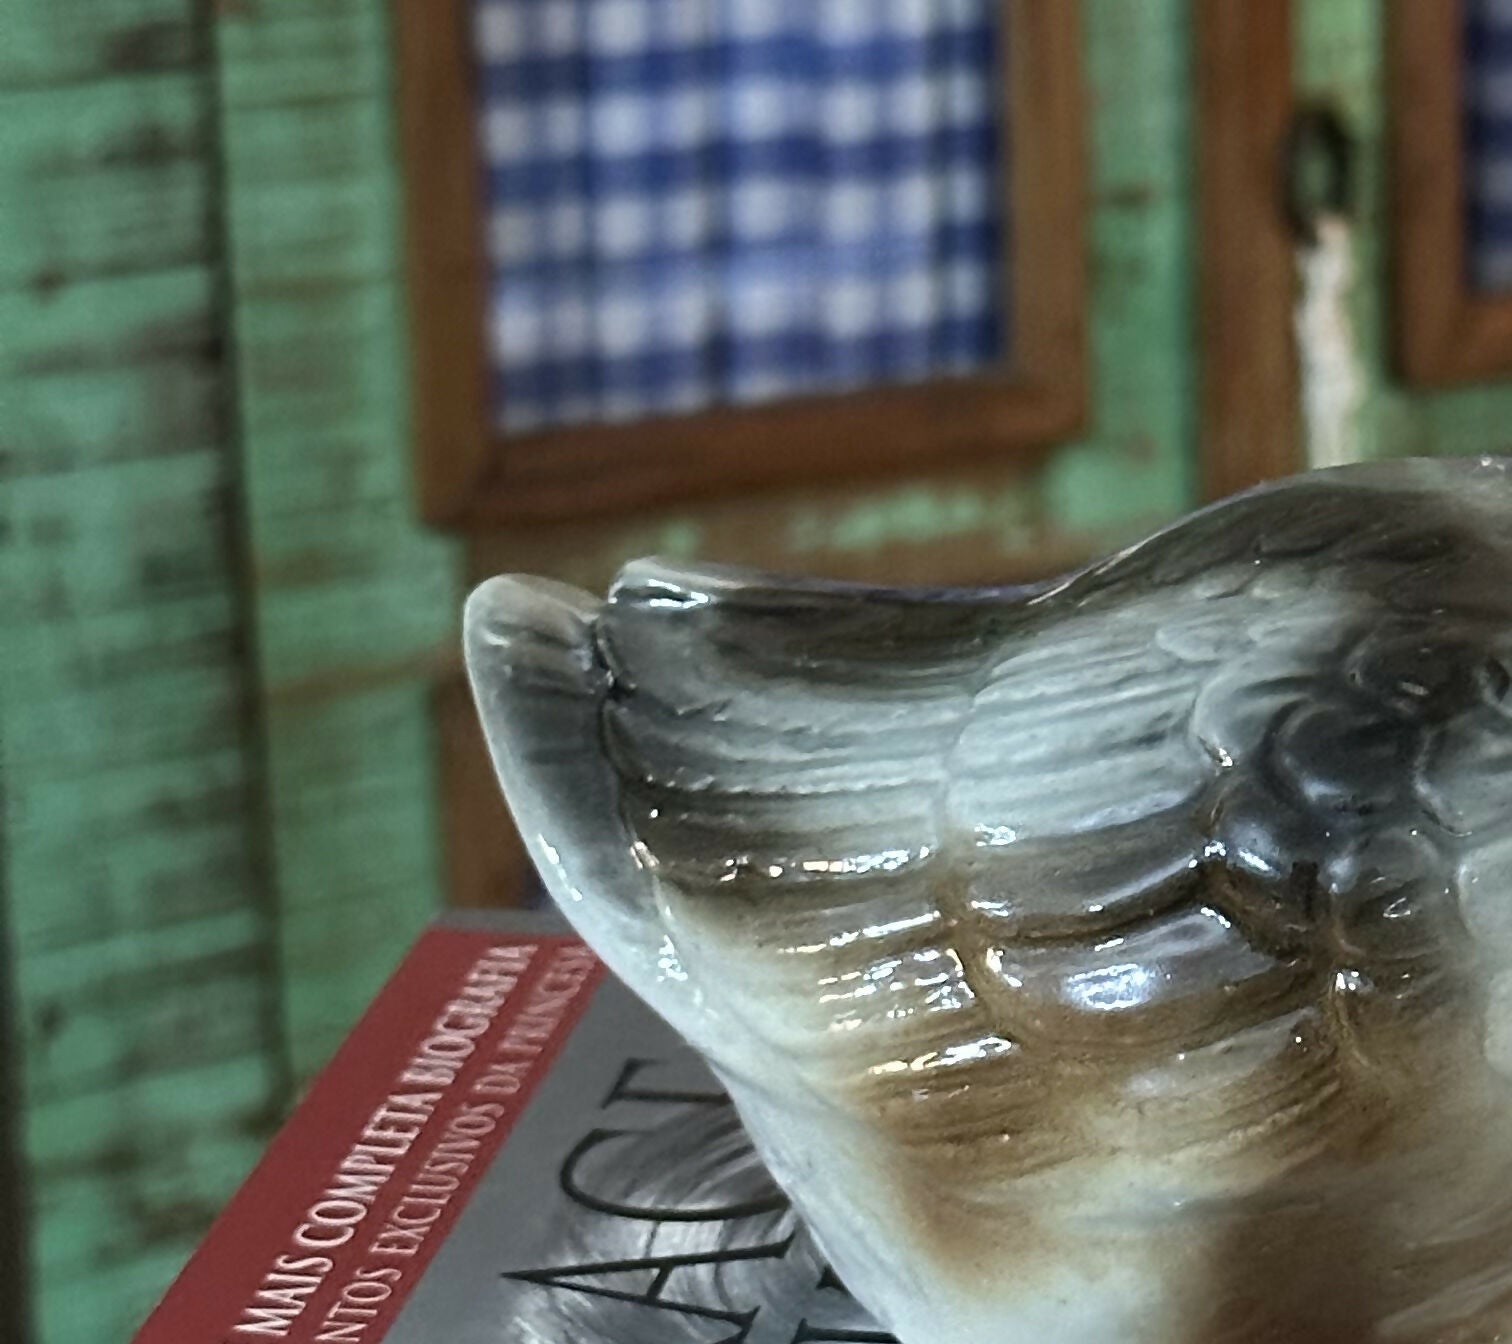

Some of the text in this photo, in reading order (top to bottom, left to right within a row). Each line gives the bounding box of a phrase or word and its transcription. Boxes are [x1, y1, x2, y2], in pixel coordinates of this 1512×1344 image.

[232, 1254, 334, 1337] MAIS
[292, 1092, 444, 1248] COMPLETA
[397, 943, 540, 1086] BIOGRAFIA
[368, 1102, 505, 1257] EXCLUSIVOS
